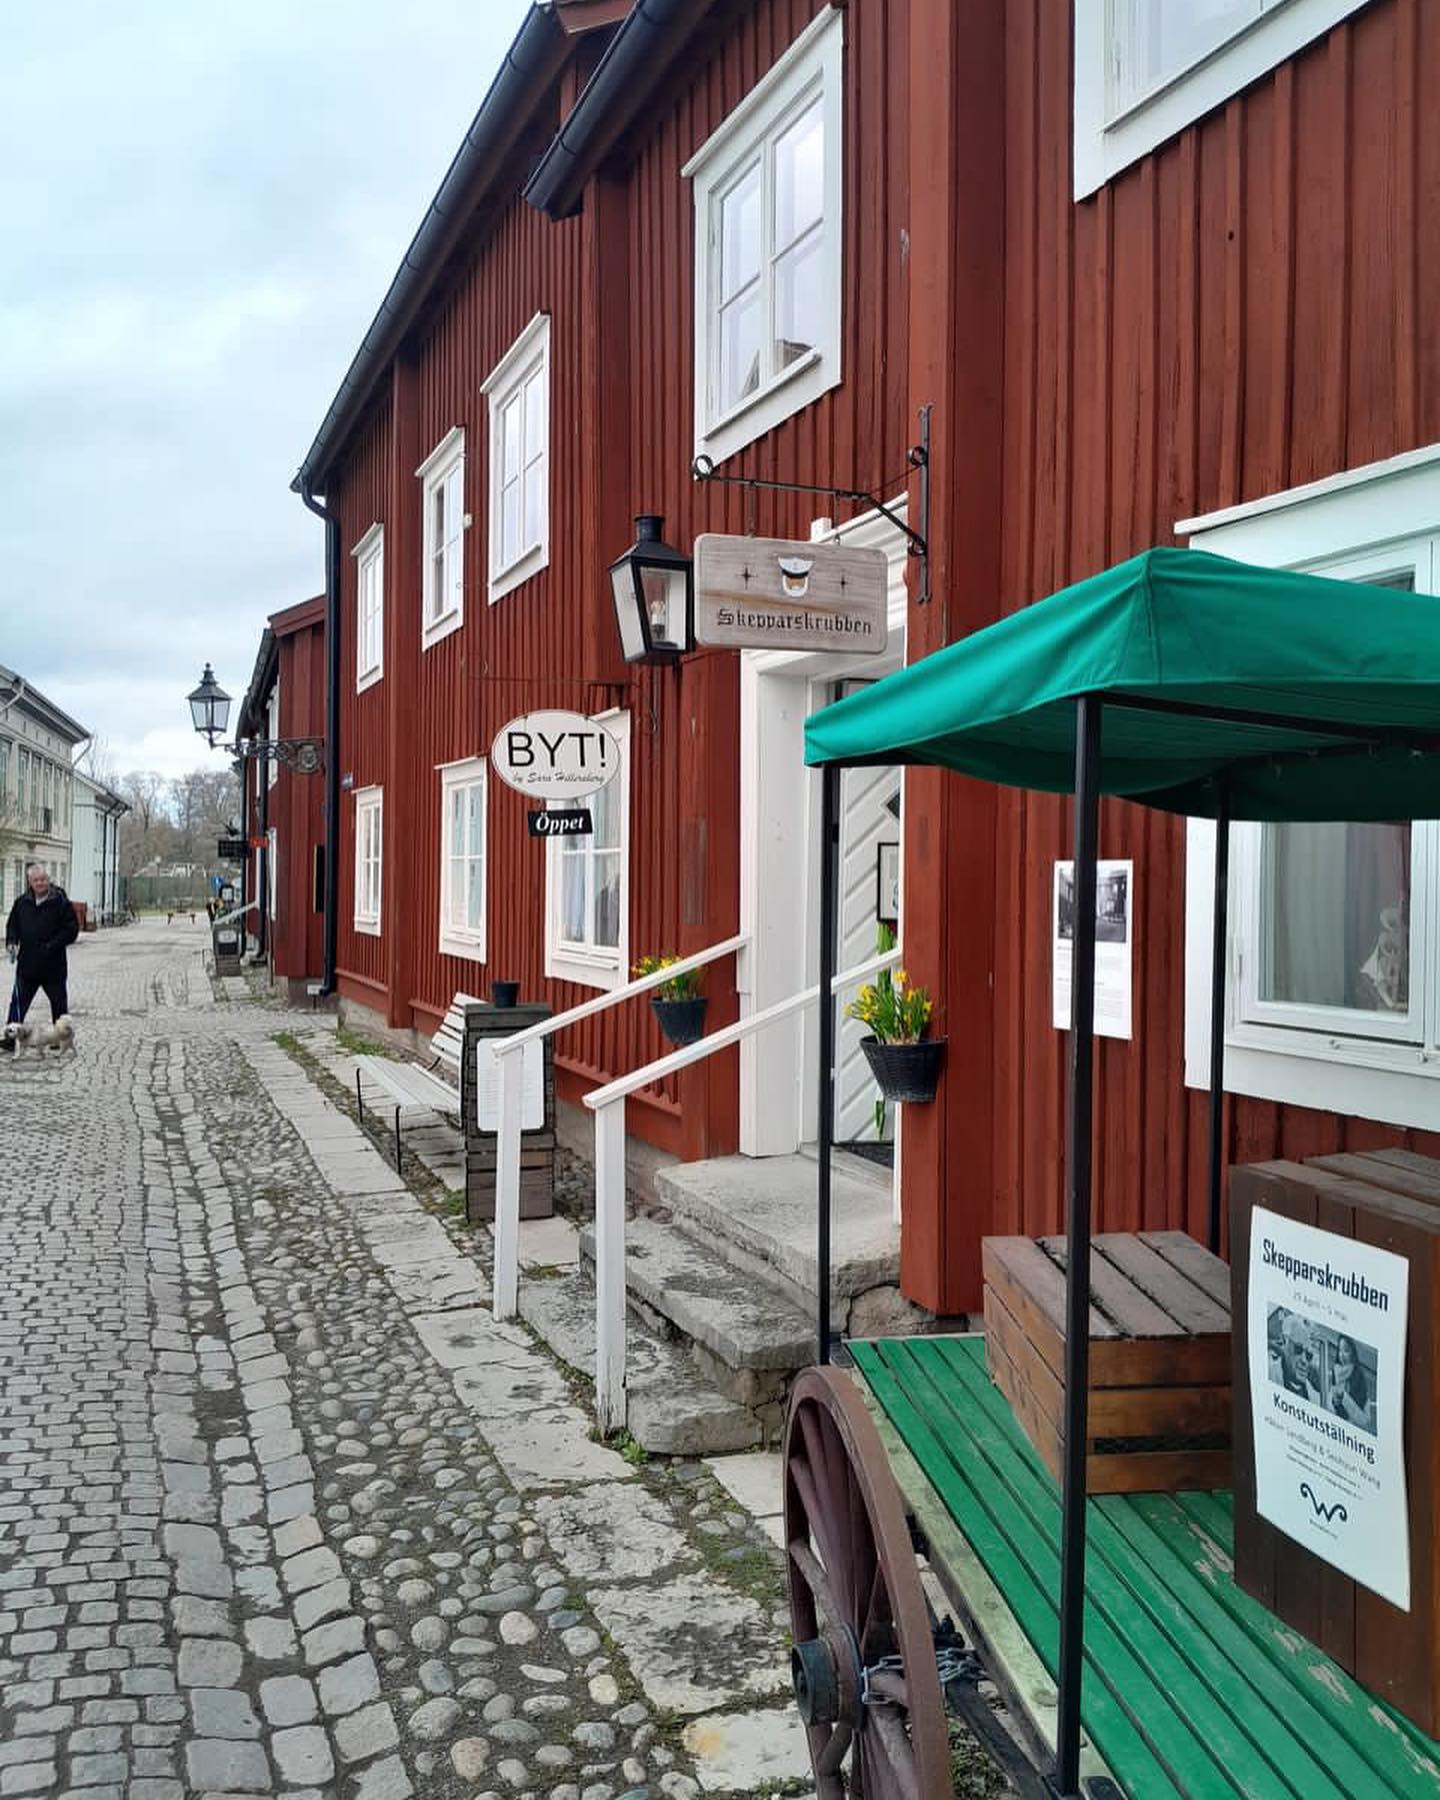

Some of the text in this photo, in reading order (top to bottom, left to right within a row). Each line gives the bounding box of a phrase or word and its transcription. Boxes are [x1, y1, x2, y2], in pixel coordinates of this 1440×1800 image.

[717, 608, 872, 636] Skepparskrubben
[508, 732, 605, 768] BYT!
[536, 812, 584, 834] Öppet
[1263, 1238, 1389, 1312] Skepparskrubben
[1273, 1393, 1376, 1464] Konstutställning
